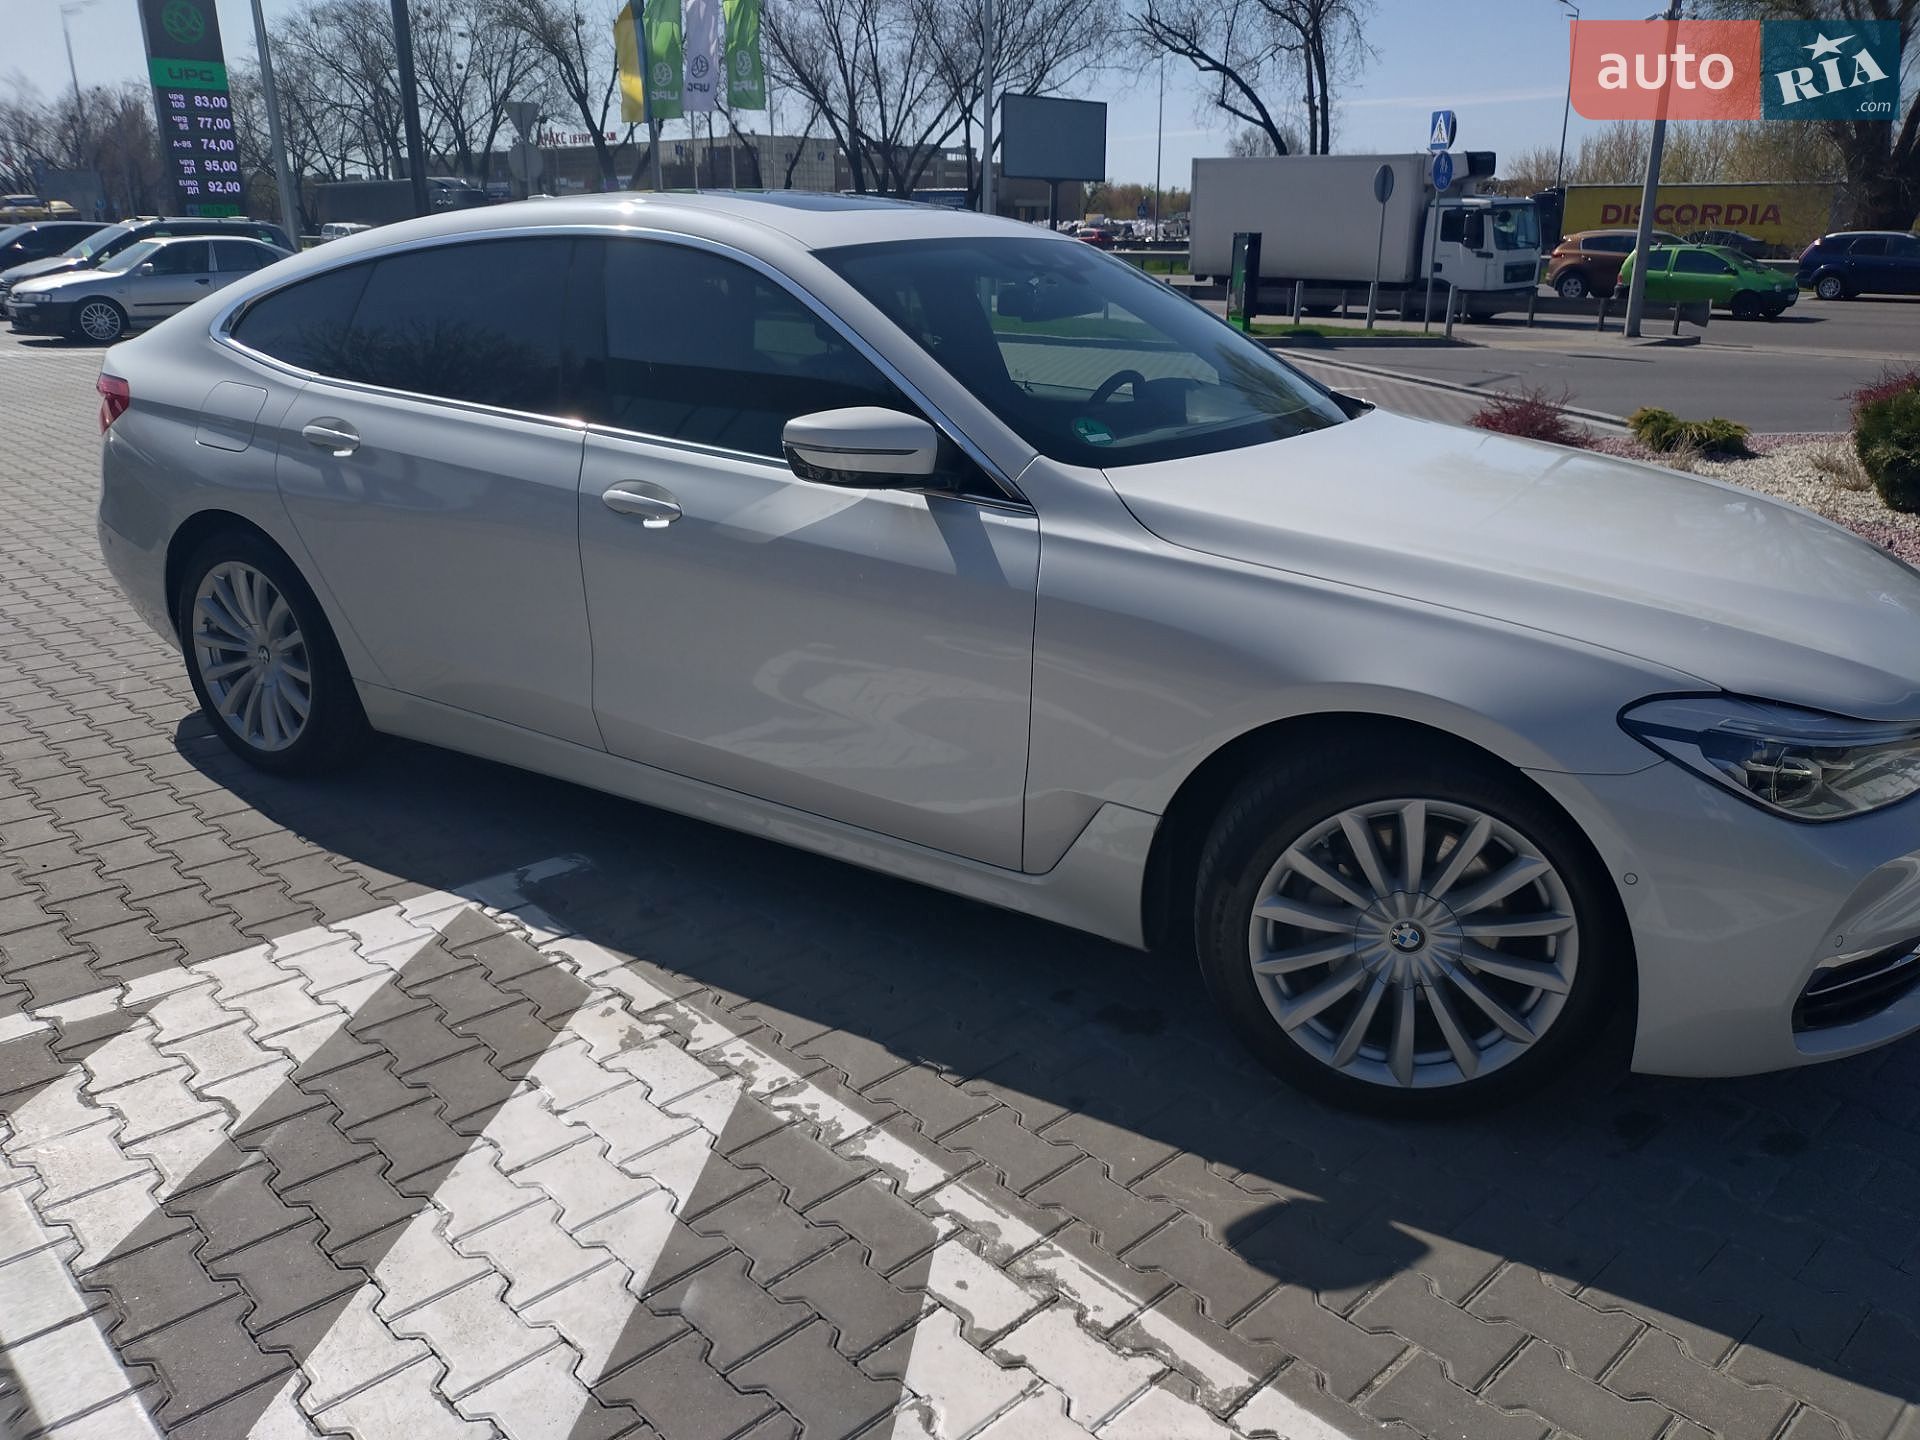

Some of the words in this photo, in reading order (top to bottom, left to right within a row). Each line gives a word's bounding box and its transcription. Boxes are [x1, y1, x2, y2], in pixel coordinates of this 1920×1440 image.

[167, 67, 216, 83] UPG
[171, 100, 186, 109] 100
[194, 95, 228, 109] 83,00
[197, 117, 231, 130] 77,00
[200, 138, 234, 152] 74,00
[204, 159, 237, 173] 95,00
[207, 181, 240, 194] 92,00
